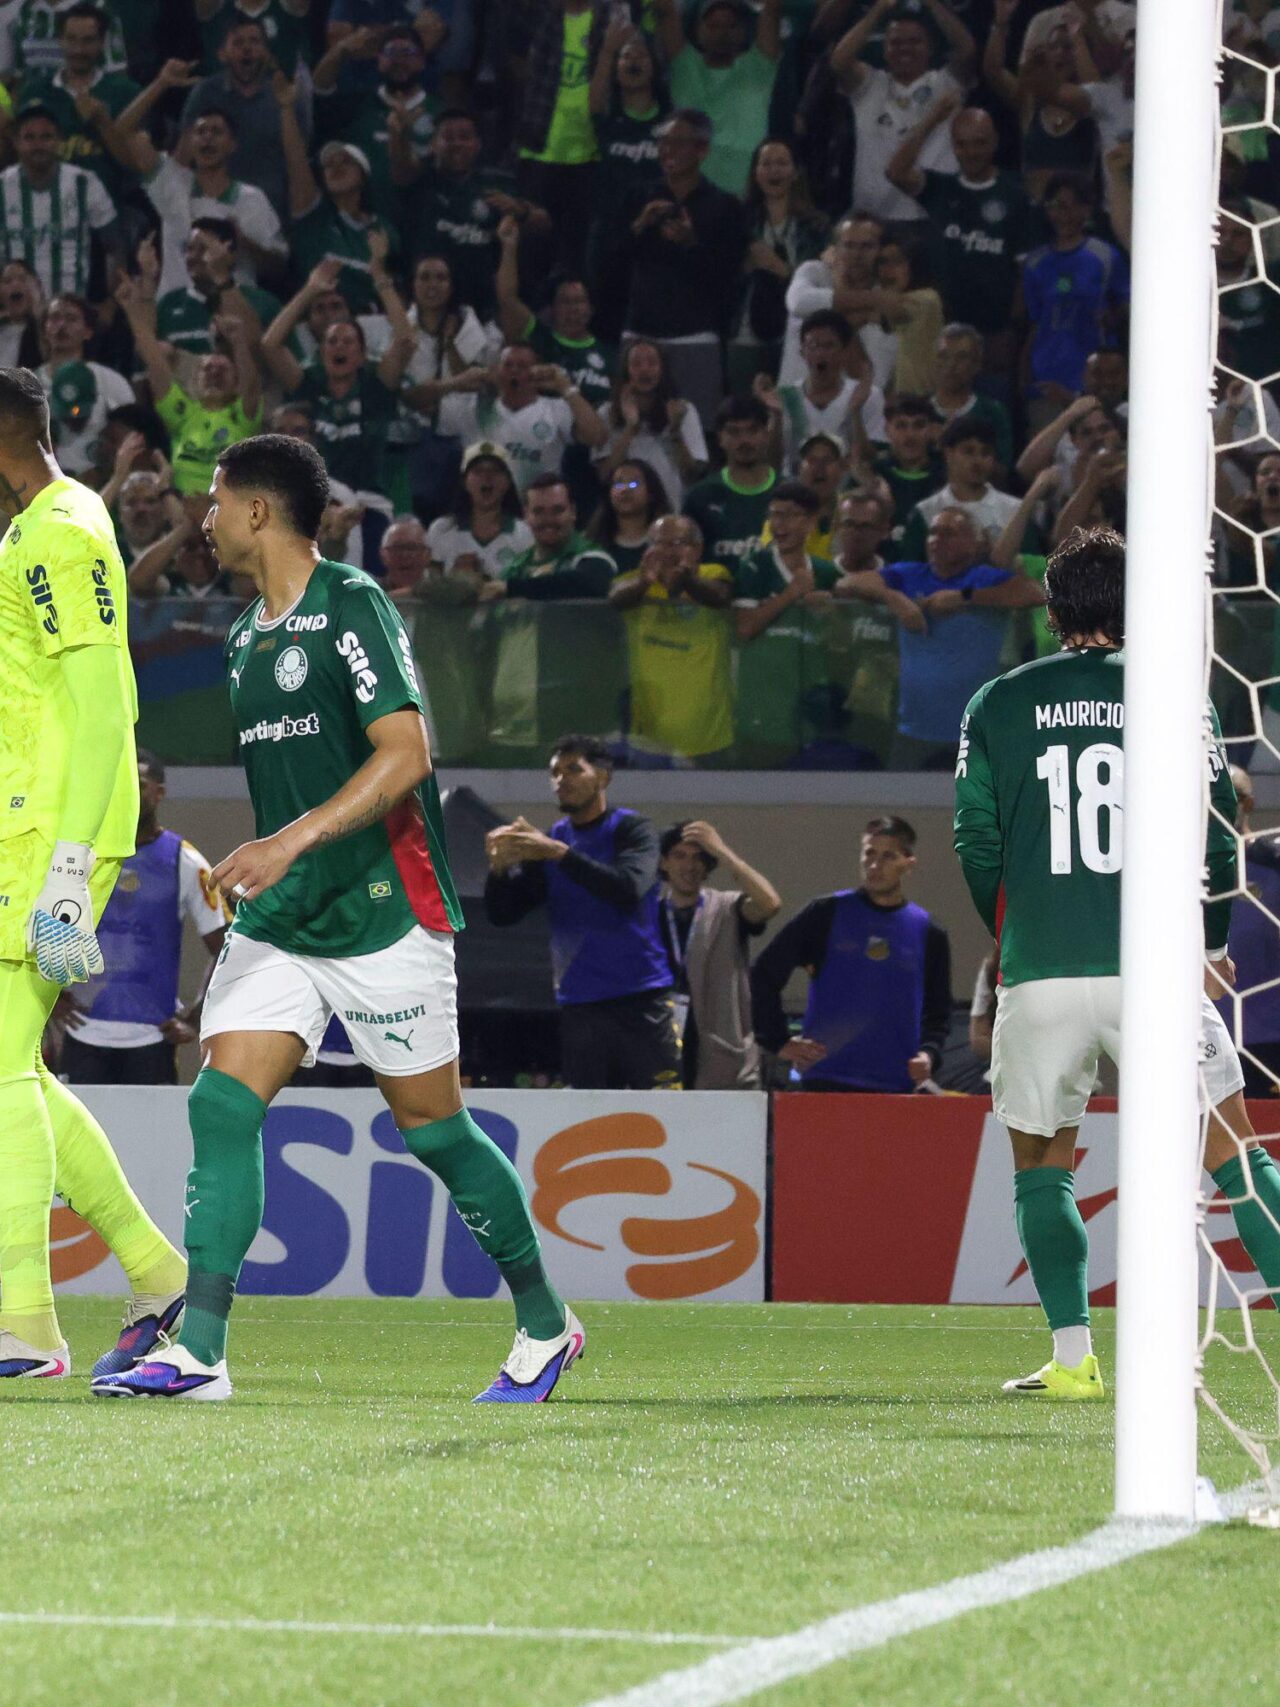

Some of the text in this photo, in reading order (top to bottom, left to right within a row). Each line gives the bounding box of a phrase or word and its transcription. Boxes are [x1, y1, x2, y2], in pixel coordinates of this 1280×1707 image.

[609, 140, 659, 163] crefis
[1035, 700, 1125, 730] MAURICIO
[1036, 742, 1126, 875] 18
[345, 1004, 426, 1026] UNIASSELVI
